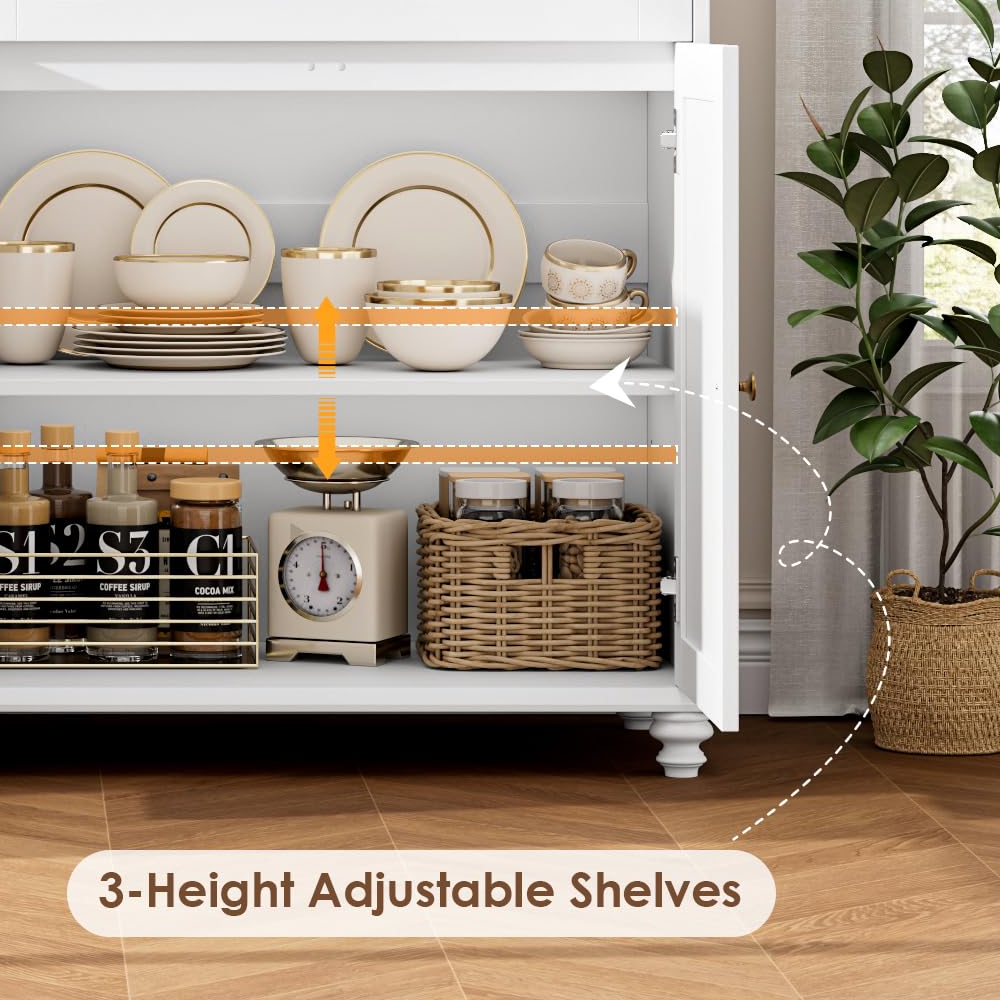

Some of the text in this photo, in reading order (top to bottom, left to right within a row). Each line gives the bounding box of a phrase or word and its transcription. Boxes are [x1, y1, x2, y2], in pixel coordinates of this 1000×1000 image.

[96, 530, 151, 575] S3
[186, 533, 234, 576] C1
[293, 560, 299, 569] 4
[20, 582, 42, 592] SIRUP
[99, 582, 151, 592] COFFEE SIRUP
[194, 585, 235, 596] COCOA MIX
[303, 595, 310, 603] 3
[336, 596, 343, 605] 2
